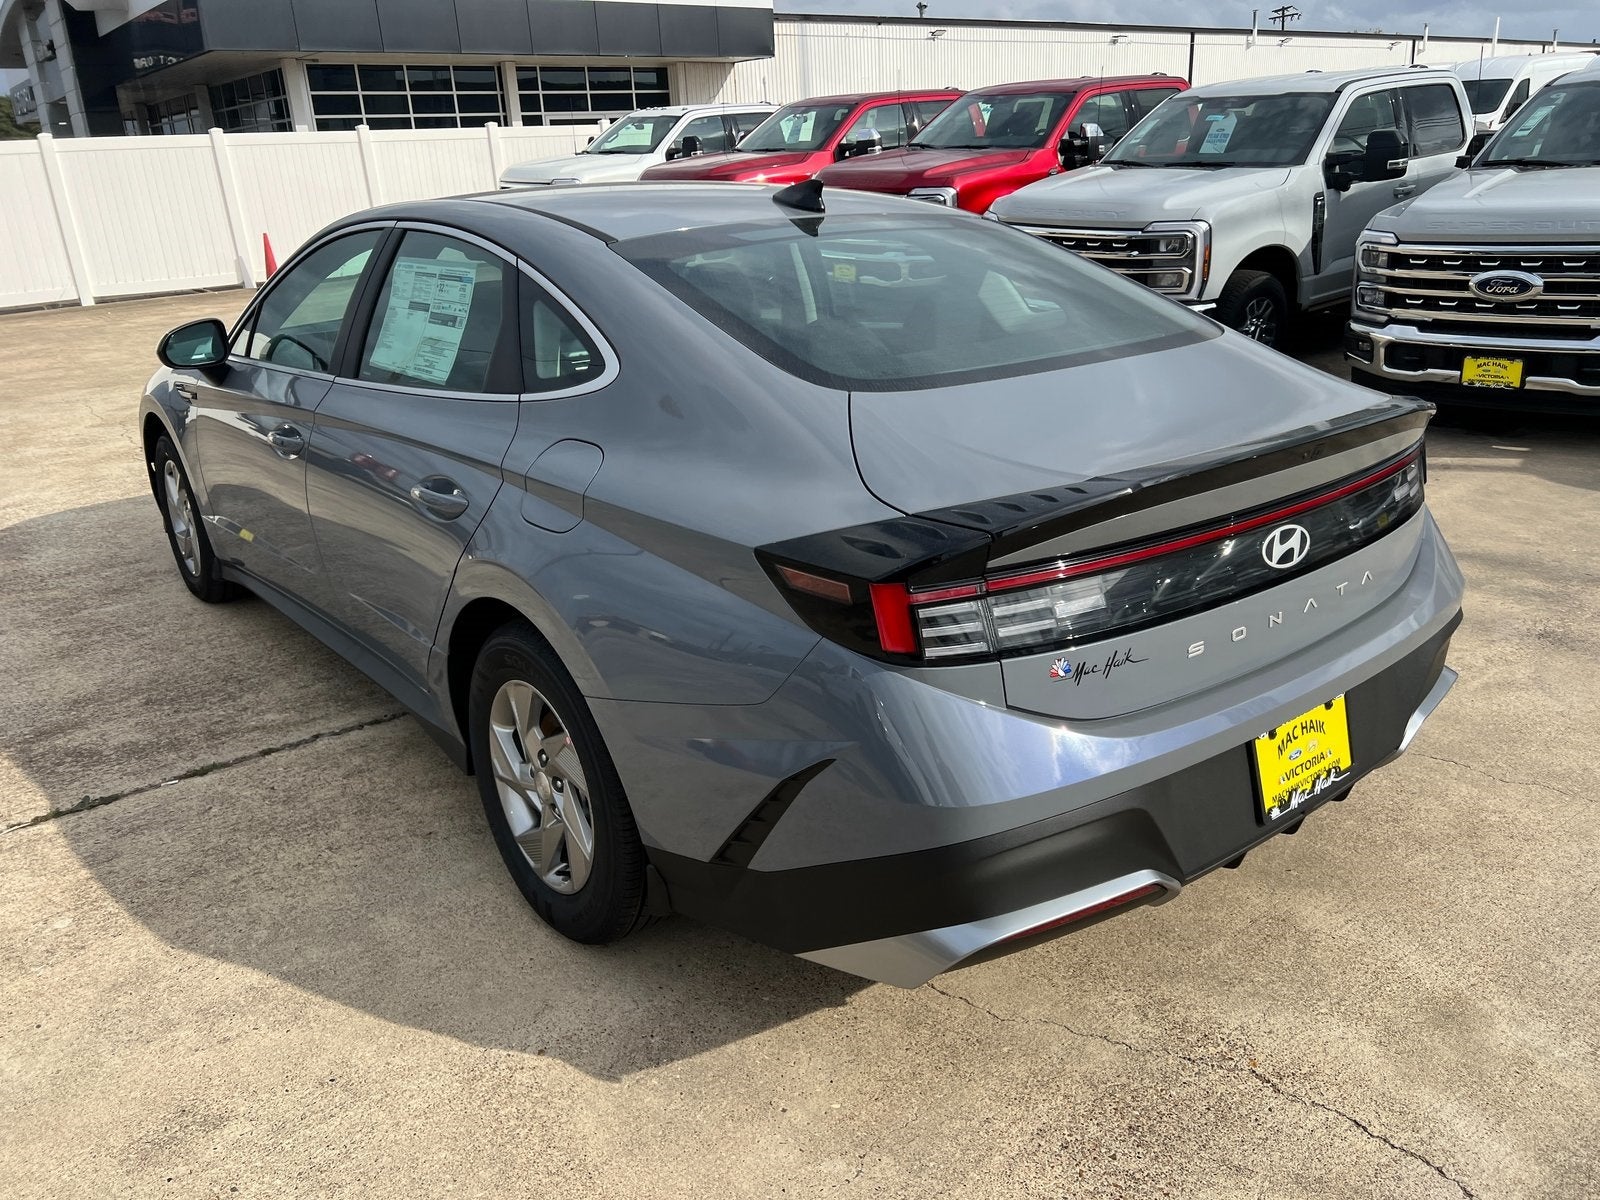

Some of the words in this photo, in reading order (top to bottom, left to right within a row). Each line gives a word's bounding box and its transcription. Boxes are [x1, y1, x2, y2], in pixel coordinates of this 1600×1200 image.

[1531, 219, 1600, 232] DUT
[1486, 279, 1520, 293] Ford
[1187, 570, 1373, 659] SONATA
[1071, 661, 1101, 686] Mac
[1103, 648, 1149, 679] Haik
[1277, 725, 1298, 760] MAC
[1300, 719, 1326, 735] HAIK
[1284, 751, 1326, 781] VICTORIA
[1290, 788, 1313, 810] Mac
[1314, 768, 1350, 795] Haik
